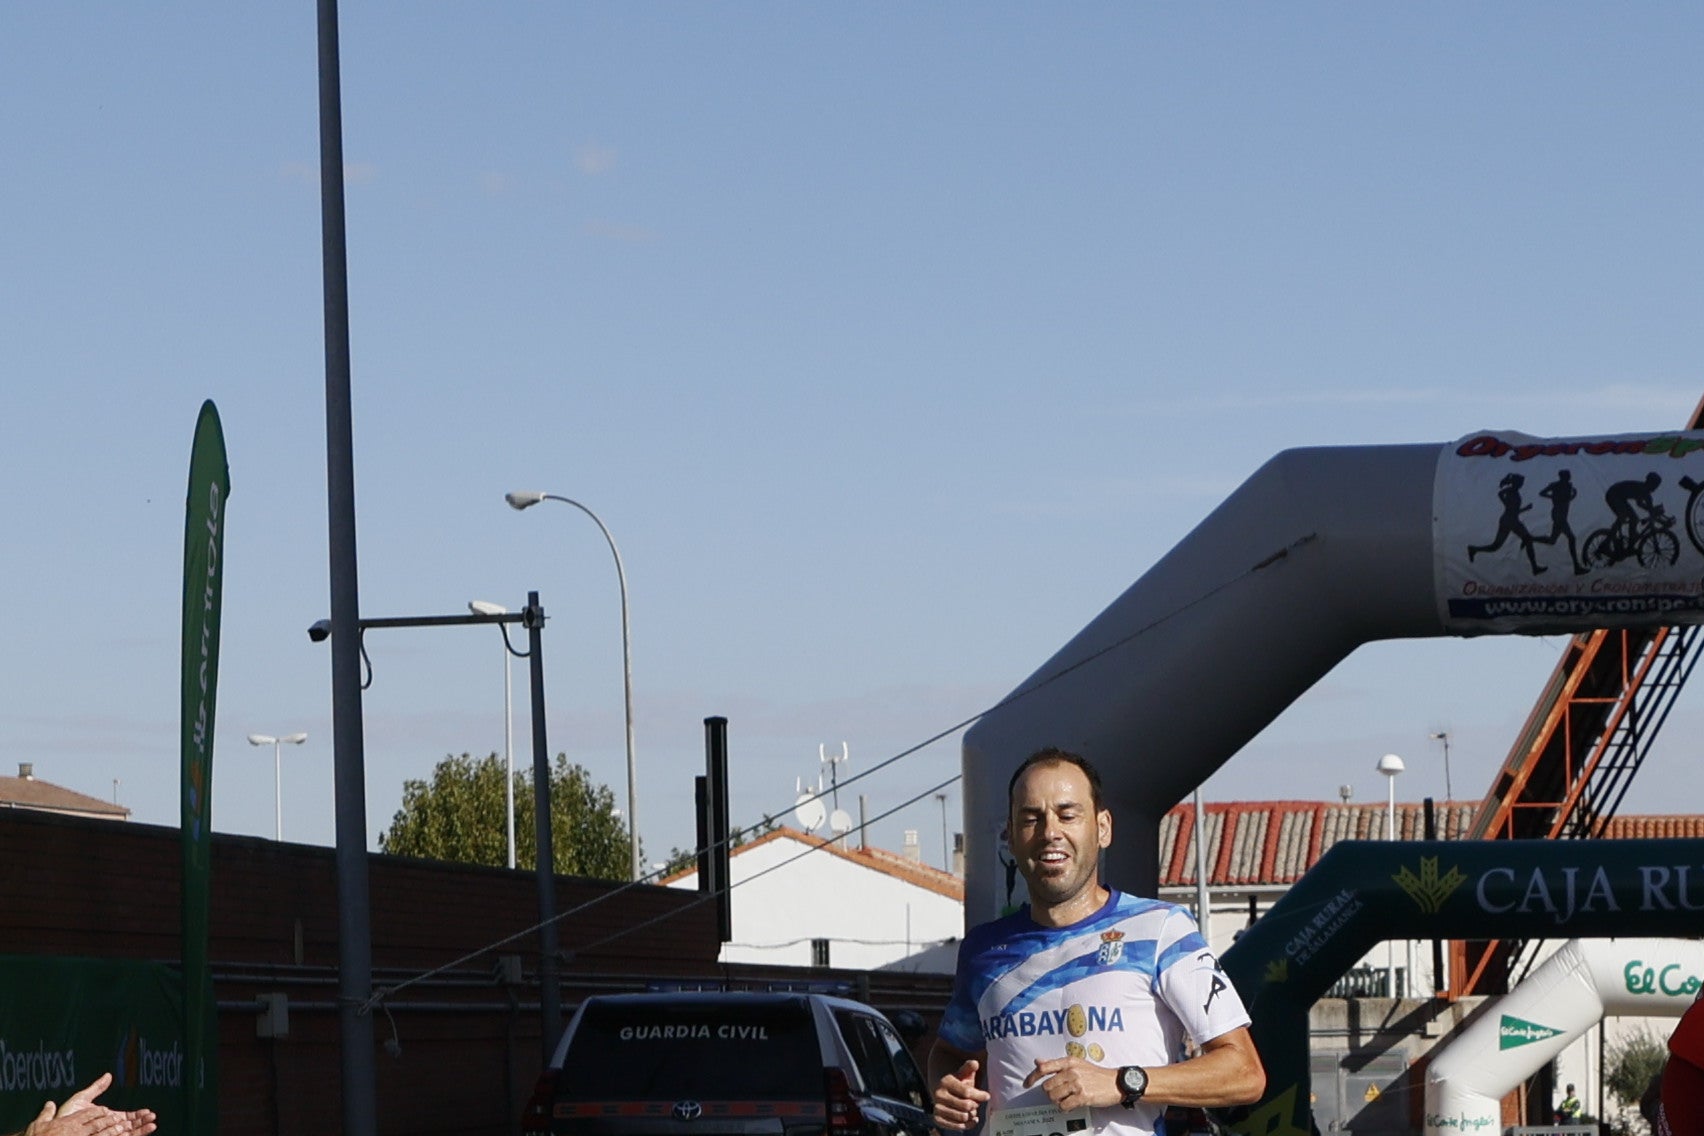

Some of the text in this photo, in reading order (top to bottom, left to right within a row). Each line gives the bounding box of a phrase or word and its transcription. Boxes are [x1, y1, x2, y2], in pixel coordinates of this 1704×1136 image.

[1476, 865, 1622, 924] CAJA
[1624, 960, 1655, 995] El
[619, 1024, 769, 1040] GUARDIA CIVIL
